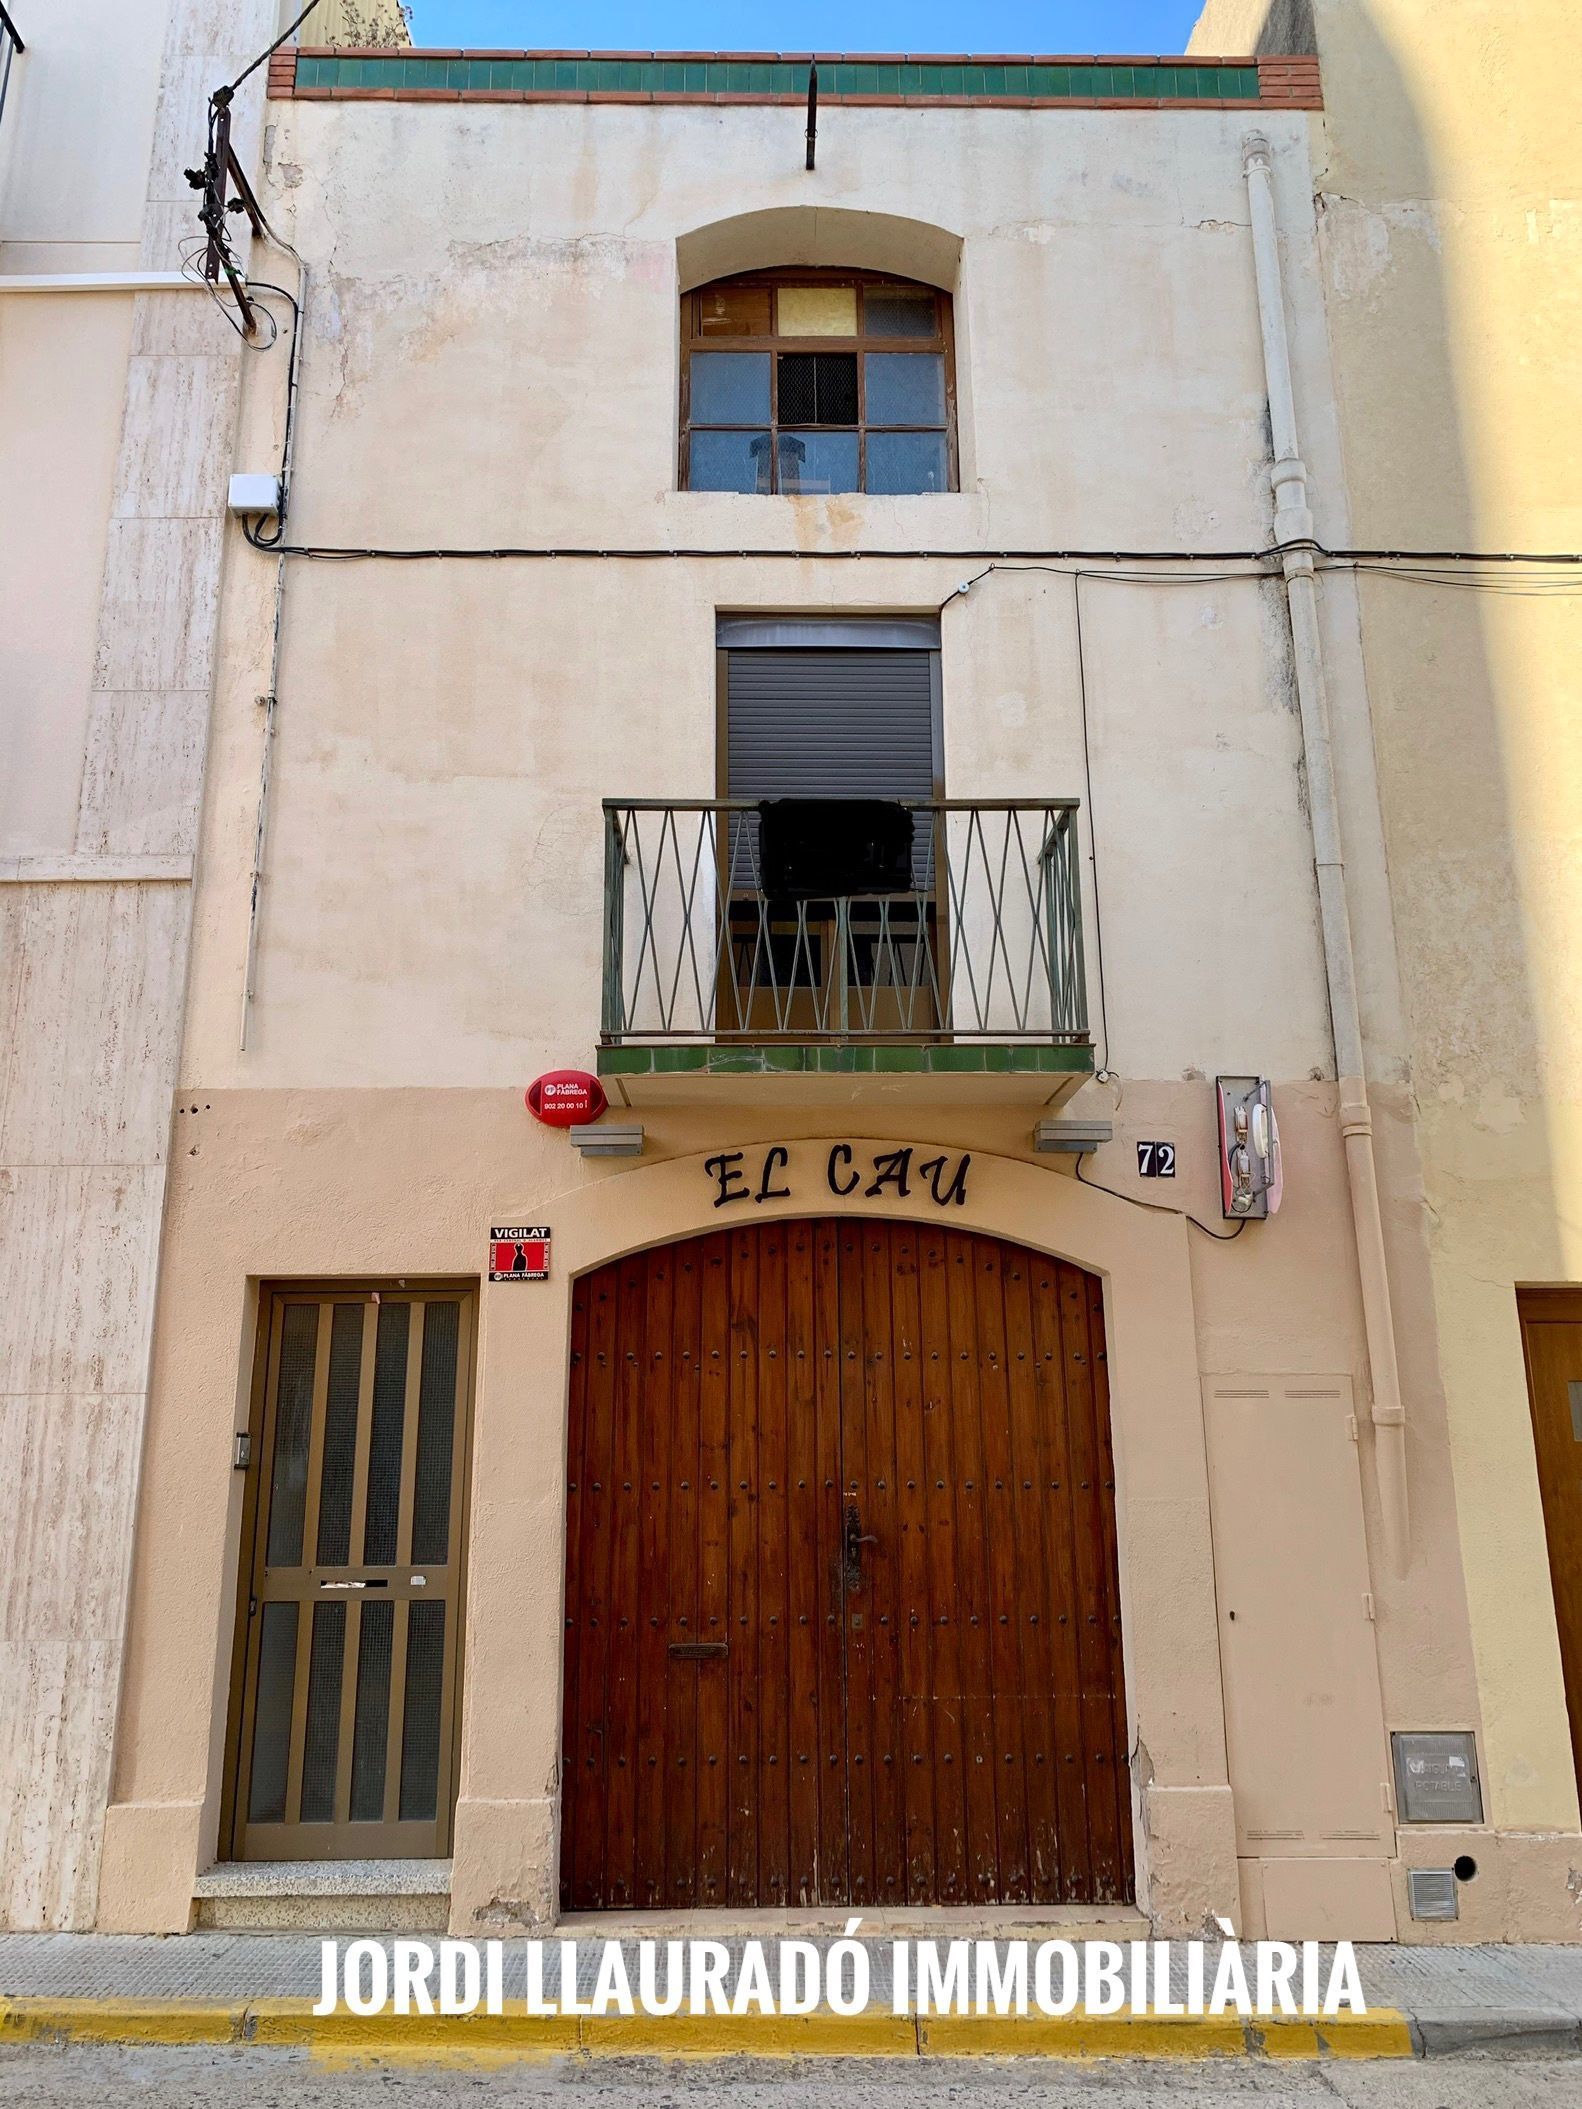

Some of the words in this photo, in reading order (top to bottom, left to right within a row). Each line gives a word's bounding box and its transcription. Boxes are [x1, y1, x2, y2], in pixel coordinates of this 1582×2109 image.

[1138, 1144, 1175, 1174] 72
[704, 1147, 791, 1208] EL
[827, 1144, 971, 1206] CAU
[494, 1228, 547, 1238] VIGILAT
